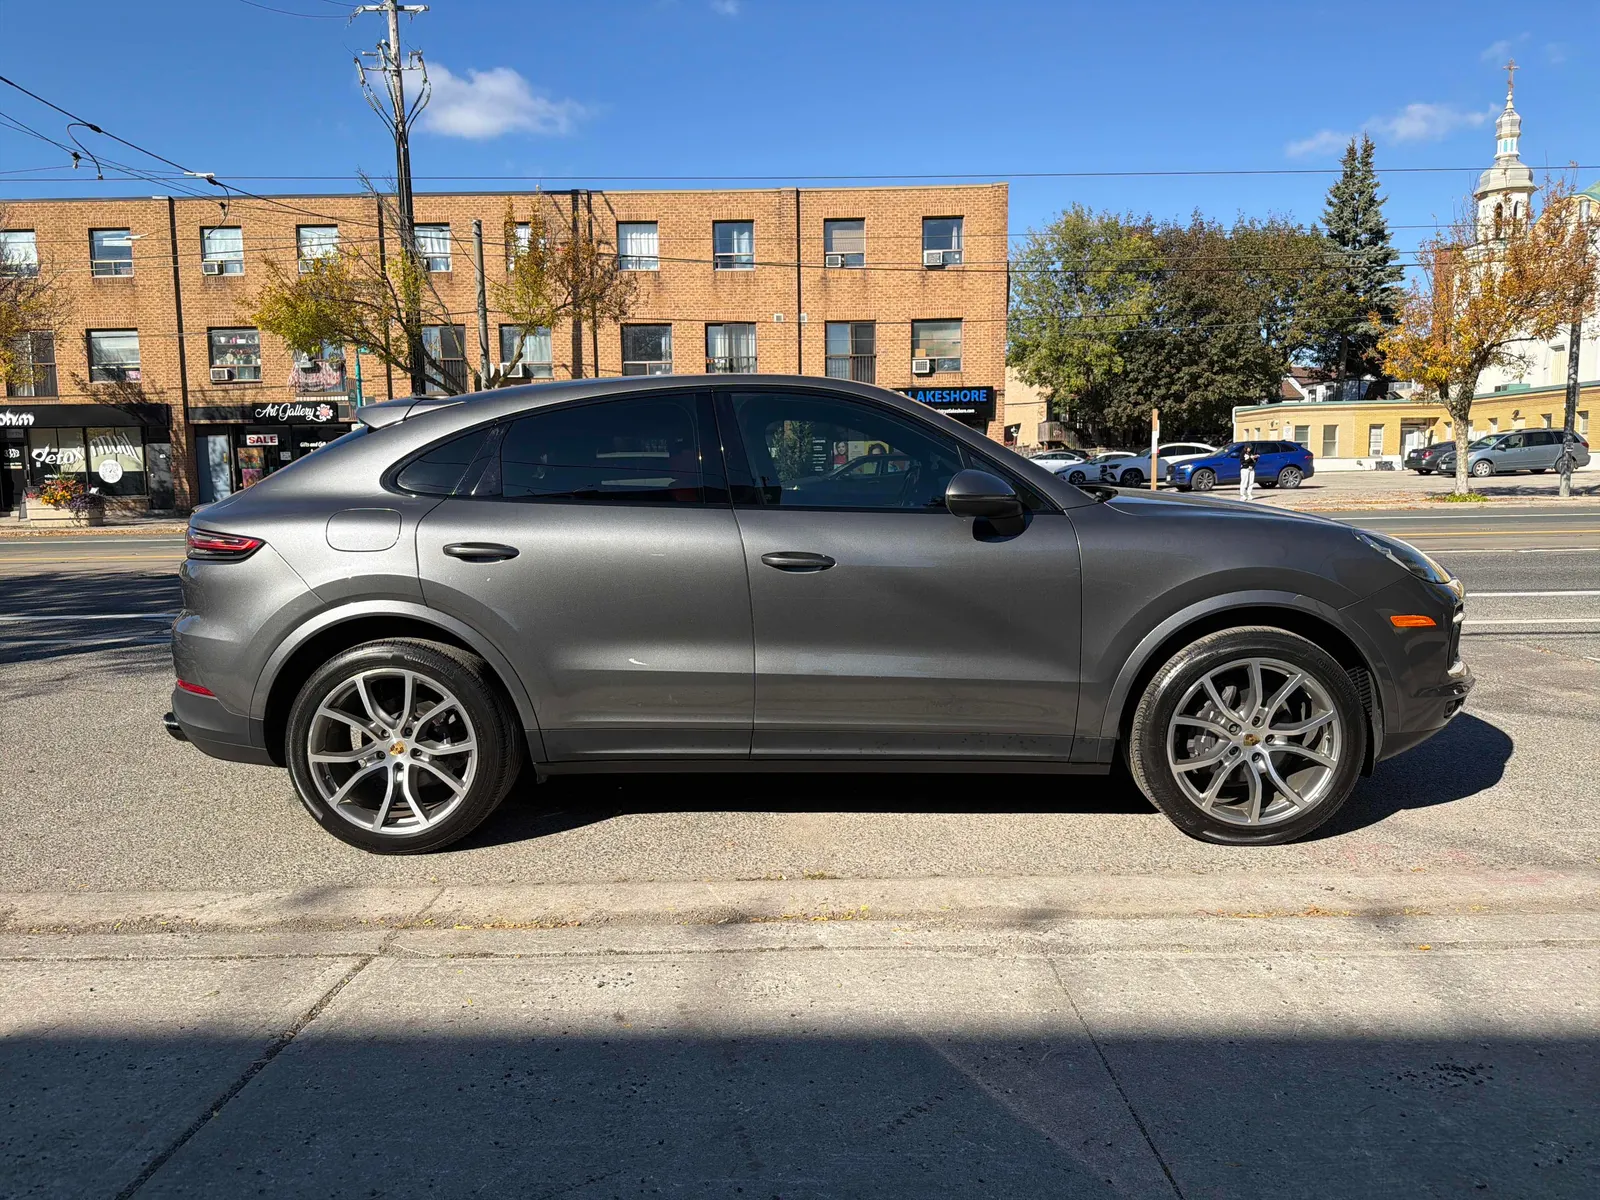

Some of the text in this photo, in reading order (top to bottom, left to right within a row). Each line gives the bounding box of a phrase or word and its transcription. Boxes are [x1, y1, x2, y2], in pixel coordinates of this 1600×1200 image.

[908, 390, 987, 402] LAKESHORE
[255, 403, 320, 422] Art Gallery
[248, 436, 277, 444] SALE
[31, 443, 85, 465] detox
